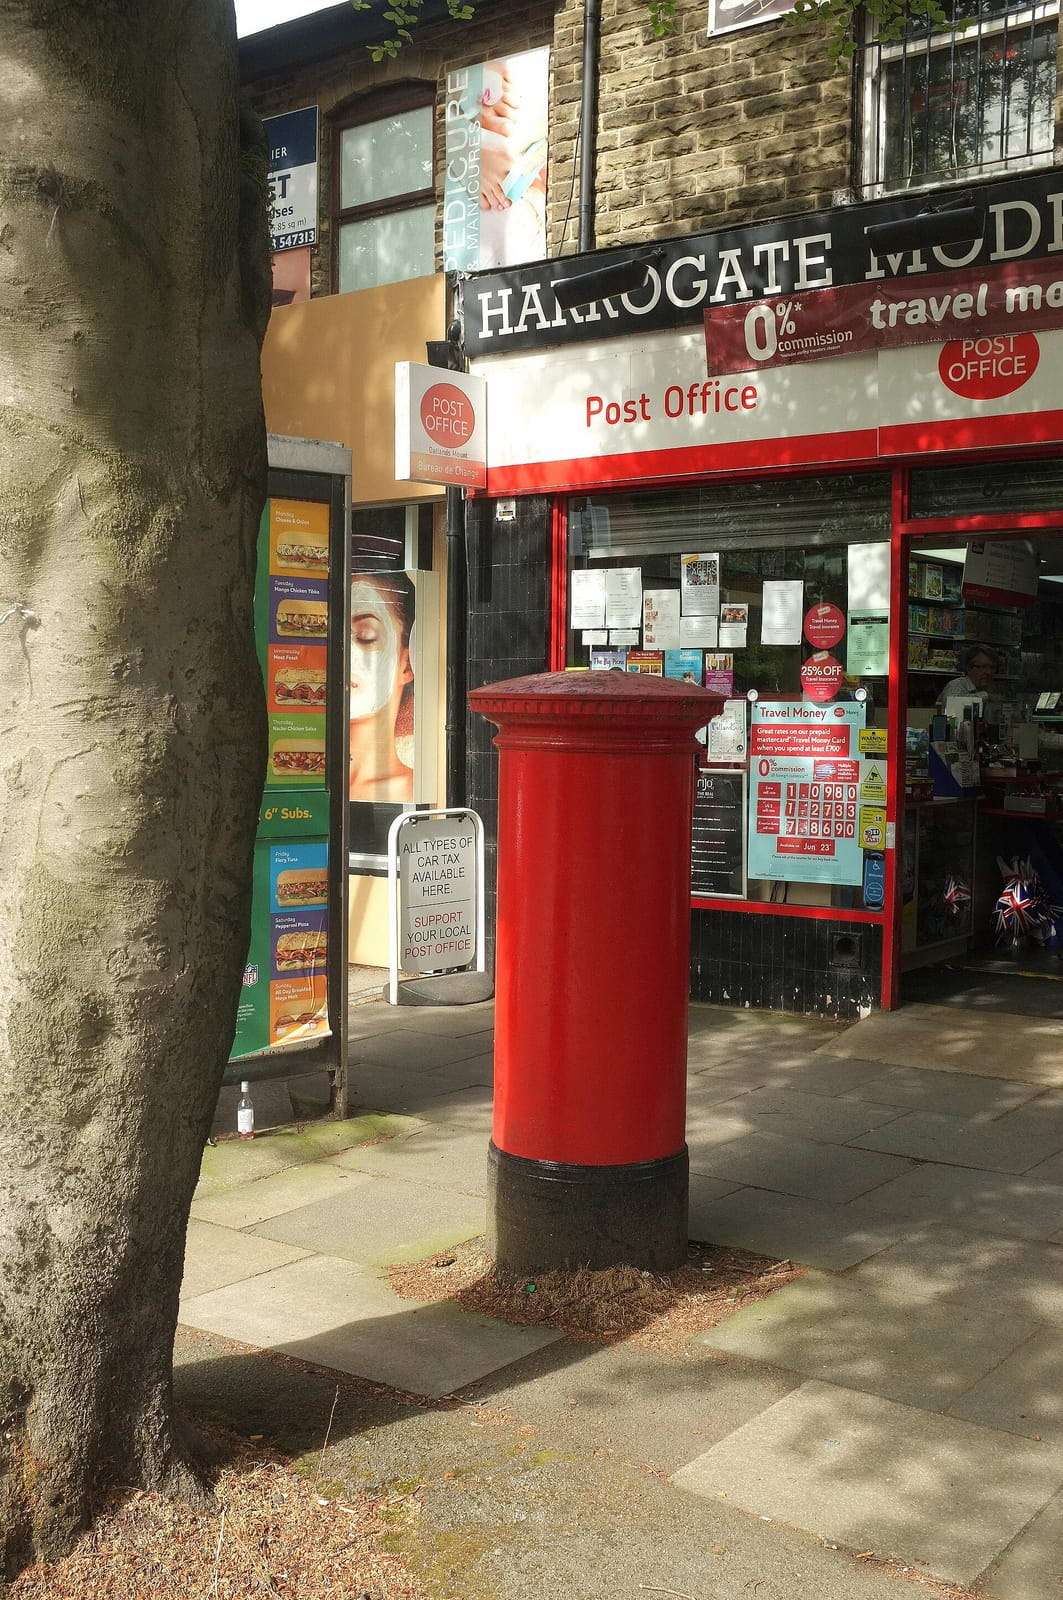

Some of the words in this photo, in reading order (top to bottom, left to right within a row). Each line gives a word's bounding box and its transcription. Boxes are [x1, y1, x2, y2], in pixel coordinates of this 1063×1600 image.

[466, 119, 482, 250] MANICURES
[279, 230, 315, 248] 547313
[869, 283, 989, 329] travel
[778, 329, 853, 352] commission
[962, 335, 1019, 358] POST
[948, 355, 1027, 382] OFFICE
[433, 397, 464, 417] POST
[587, 393, 651, 427] Post
[664, 381, 758, 418] Office
[425, 415, 468, 437] OFFICE
[418, 460, 443, 474] Bureau
[444, 464, 453, 475] de
[455, 465, 480, 479] Change
[801, 665, 823, 676] 25%
[823, 665, 842, 676] OFF
[760, 706, 790, 718] Travel
[793, 707, 827, 720] Money
[809, 728, 831, 737] prepaid
[811, 737, 831, 745] Money
[786, 745, 804, 753] spend
[281, 806, 313, 819] Subs.
[403, 840, 422, 854] ALL
[423, 838, 457, 851] TYPES
[459, 837, 473, 849] OF
[803, 843, 816, 851] Jun
[417, 855, 439, 867] CAR
[442, 853, 461, 865] TAX
[412, 867, 465, 883] AVAILABLE
[422, 884, 453, 897] HERE.
[414, 911, 463, 928] SUPPORT
[407, 929, 437, 944] YOUR
[439, 925, 471, 939] LOCAL
[404, 944, 432, 959] POST
[435, 939, 471, 954] OFFICE
